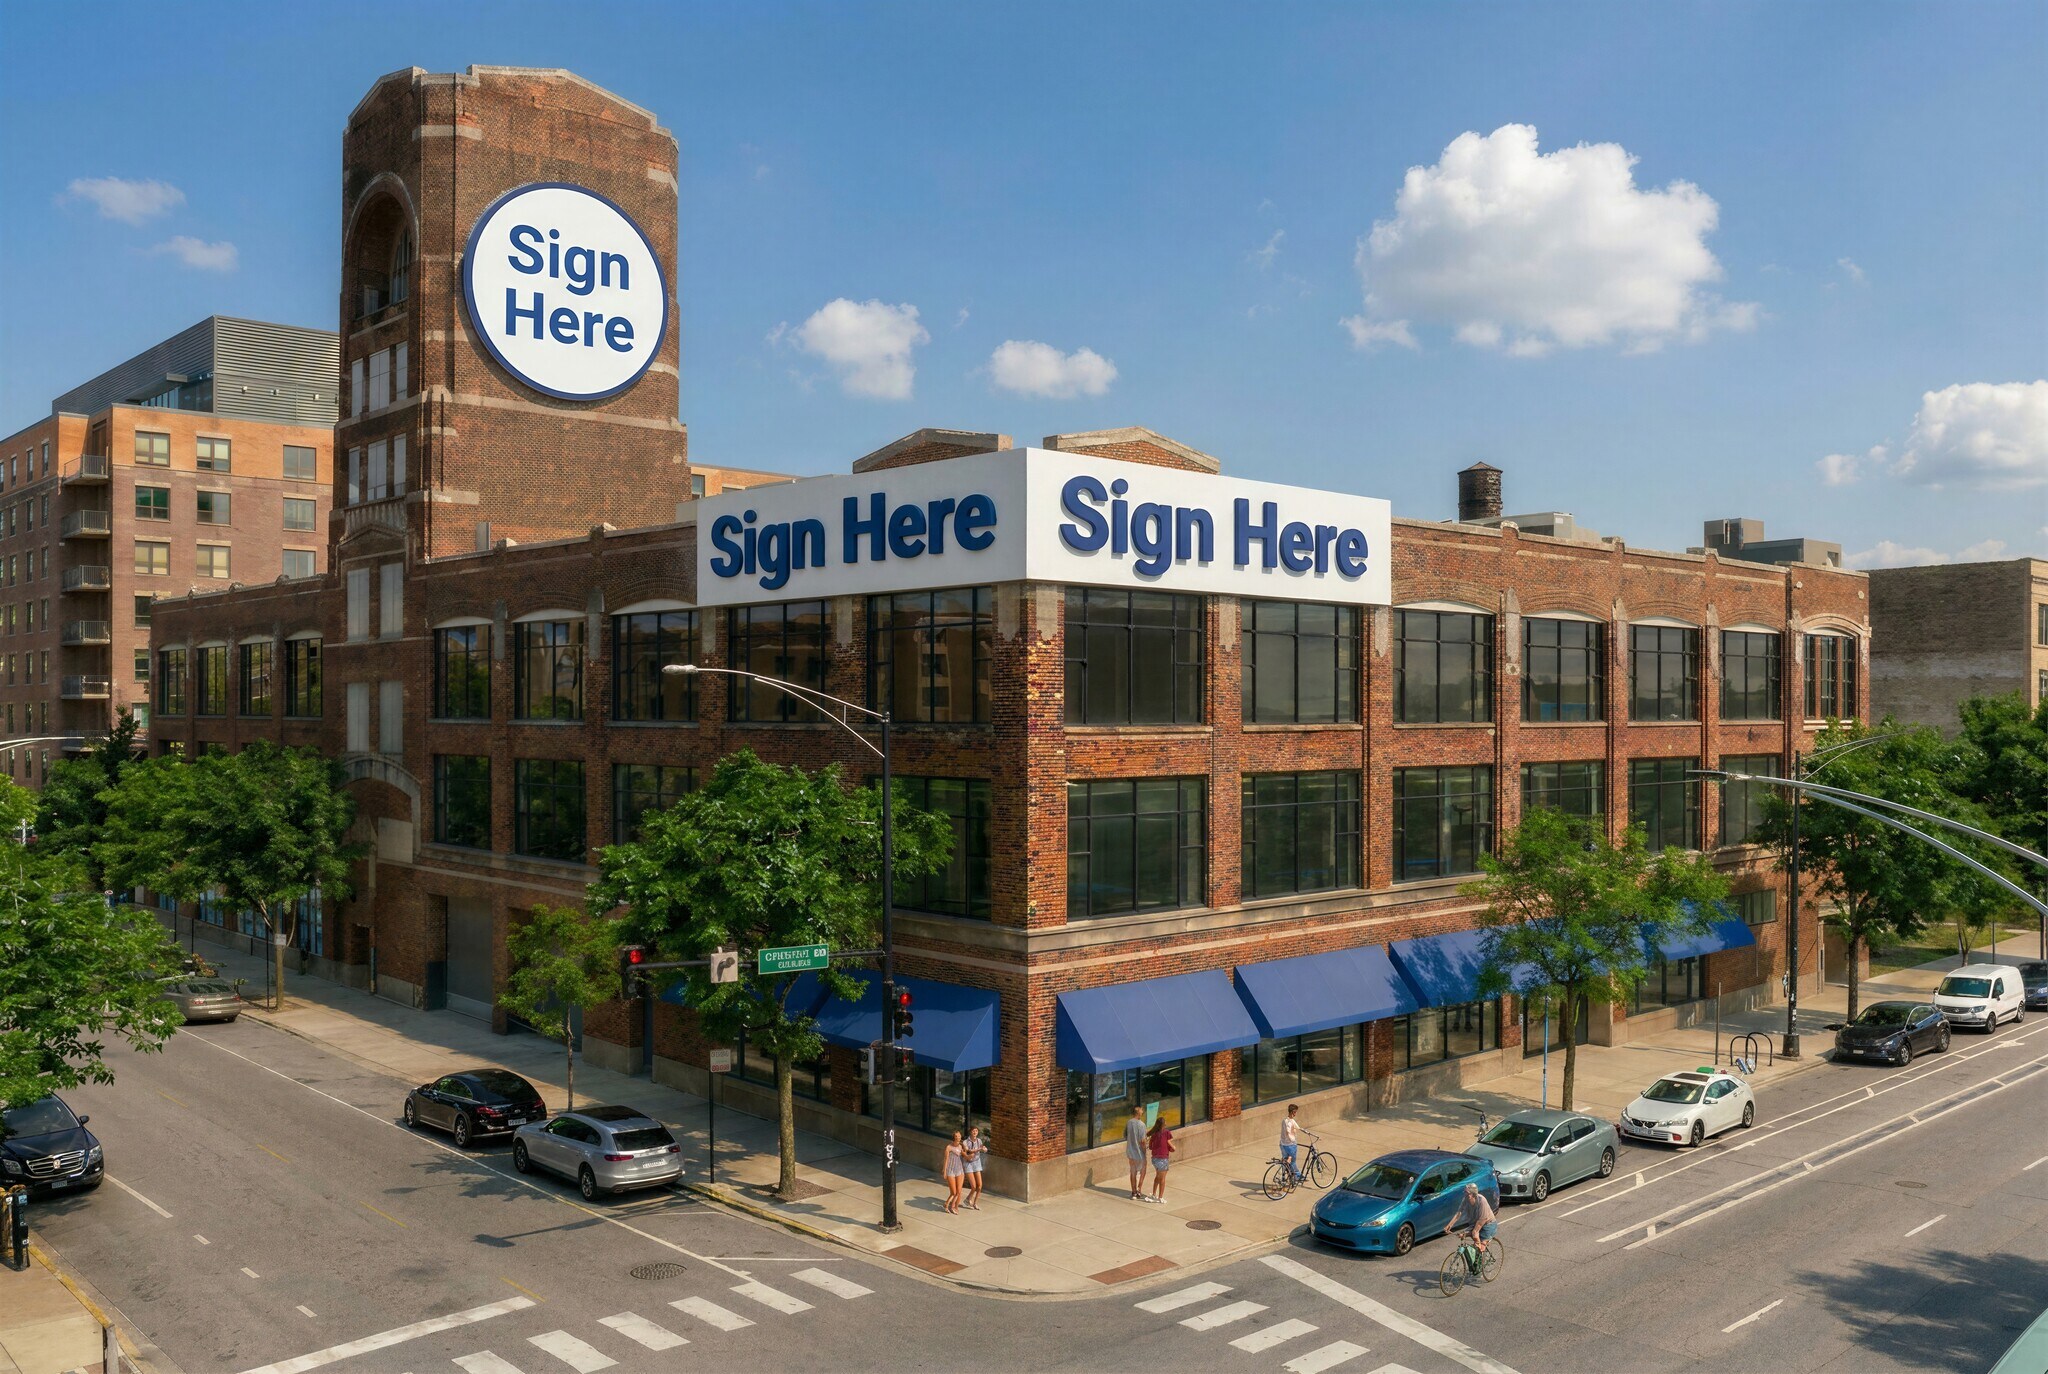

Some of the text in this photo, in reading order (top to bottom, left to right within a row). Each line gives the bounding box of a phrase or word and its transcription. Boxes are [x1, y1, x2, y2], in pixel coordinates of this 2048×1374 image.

[507, 224, 630, 296] Sign
[505, 287, 635, 353] Here
[710, 492, 998, 590] Sign Here
[1059, 475, 1369, 578] Sign Here
